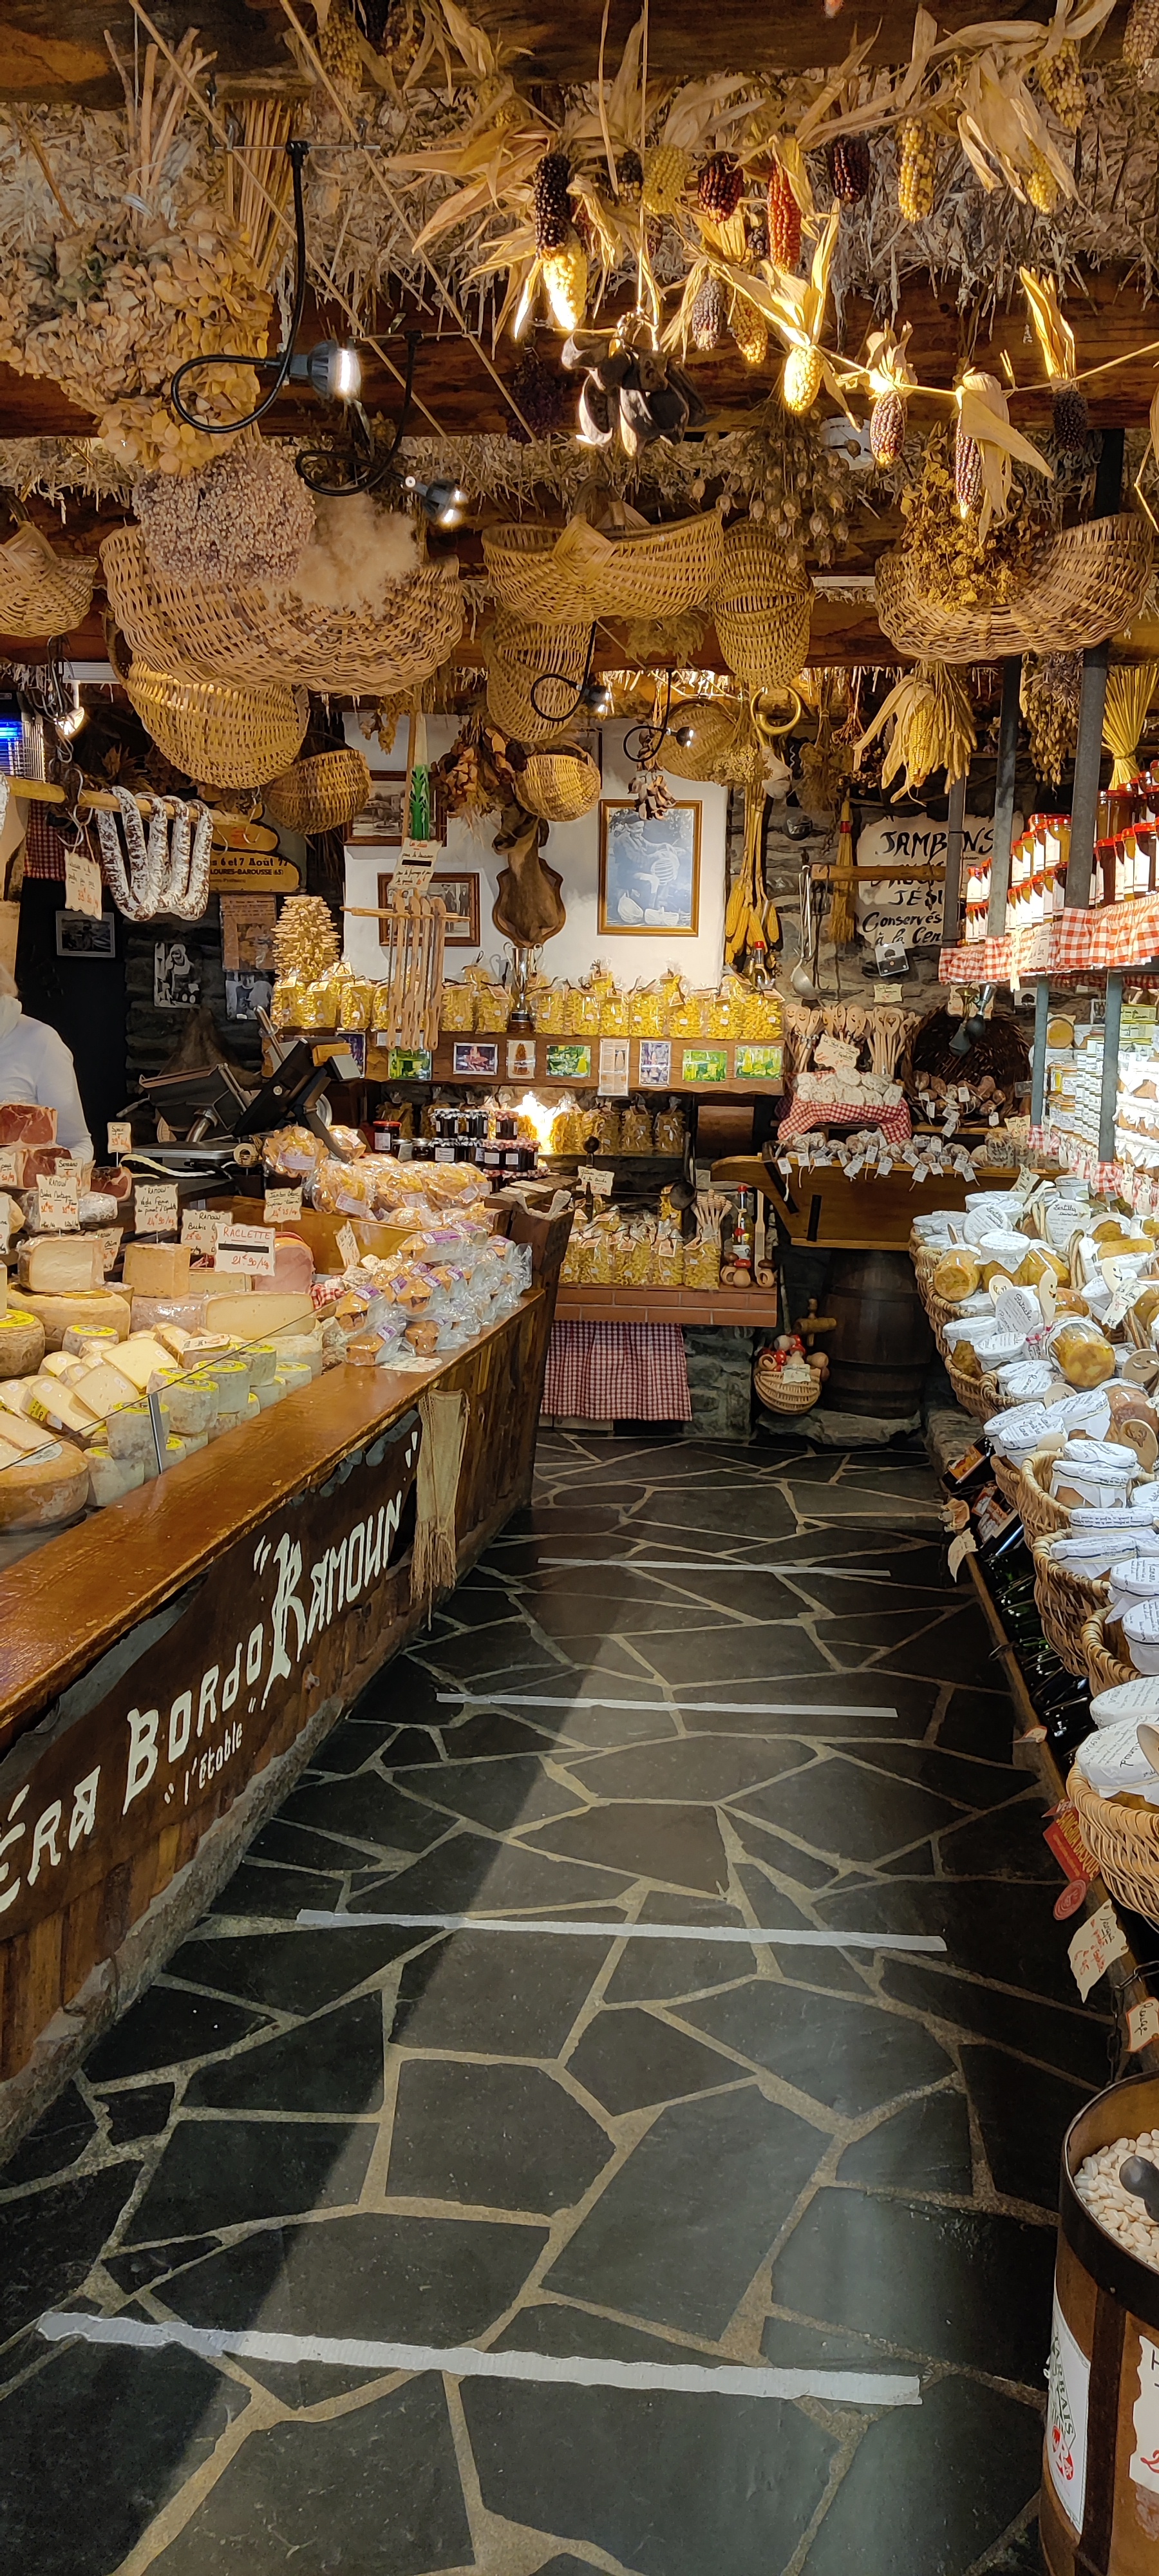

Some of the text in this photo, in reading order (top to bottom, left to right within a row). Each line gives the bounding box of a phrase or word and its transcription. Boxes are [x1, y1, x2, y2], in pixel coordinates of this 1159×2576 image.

[876, 827, 994, 862] JAMBNS
[221, 857, 226, 866] 6
[240, 857, 245, 866] 7
[862, 911, 943, 933] Conservés
[912, 927, 943, 944] Cen
[223, 1226, 272, 1240] RACLETTE
